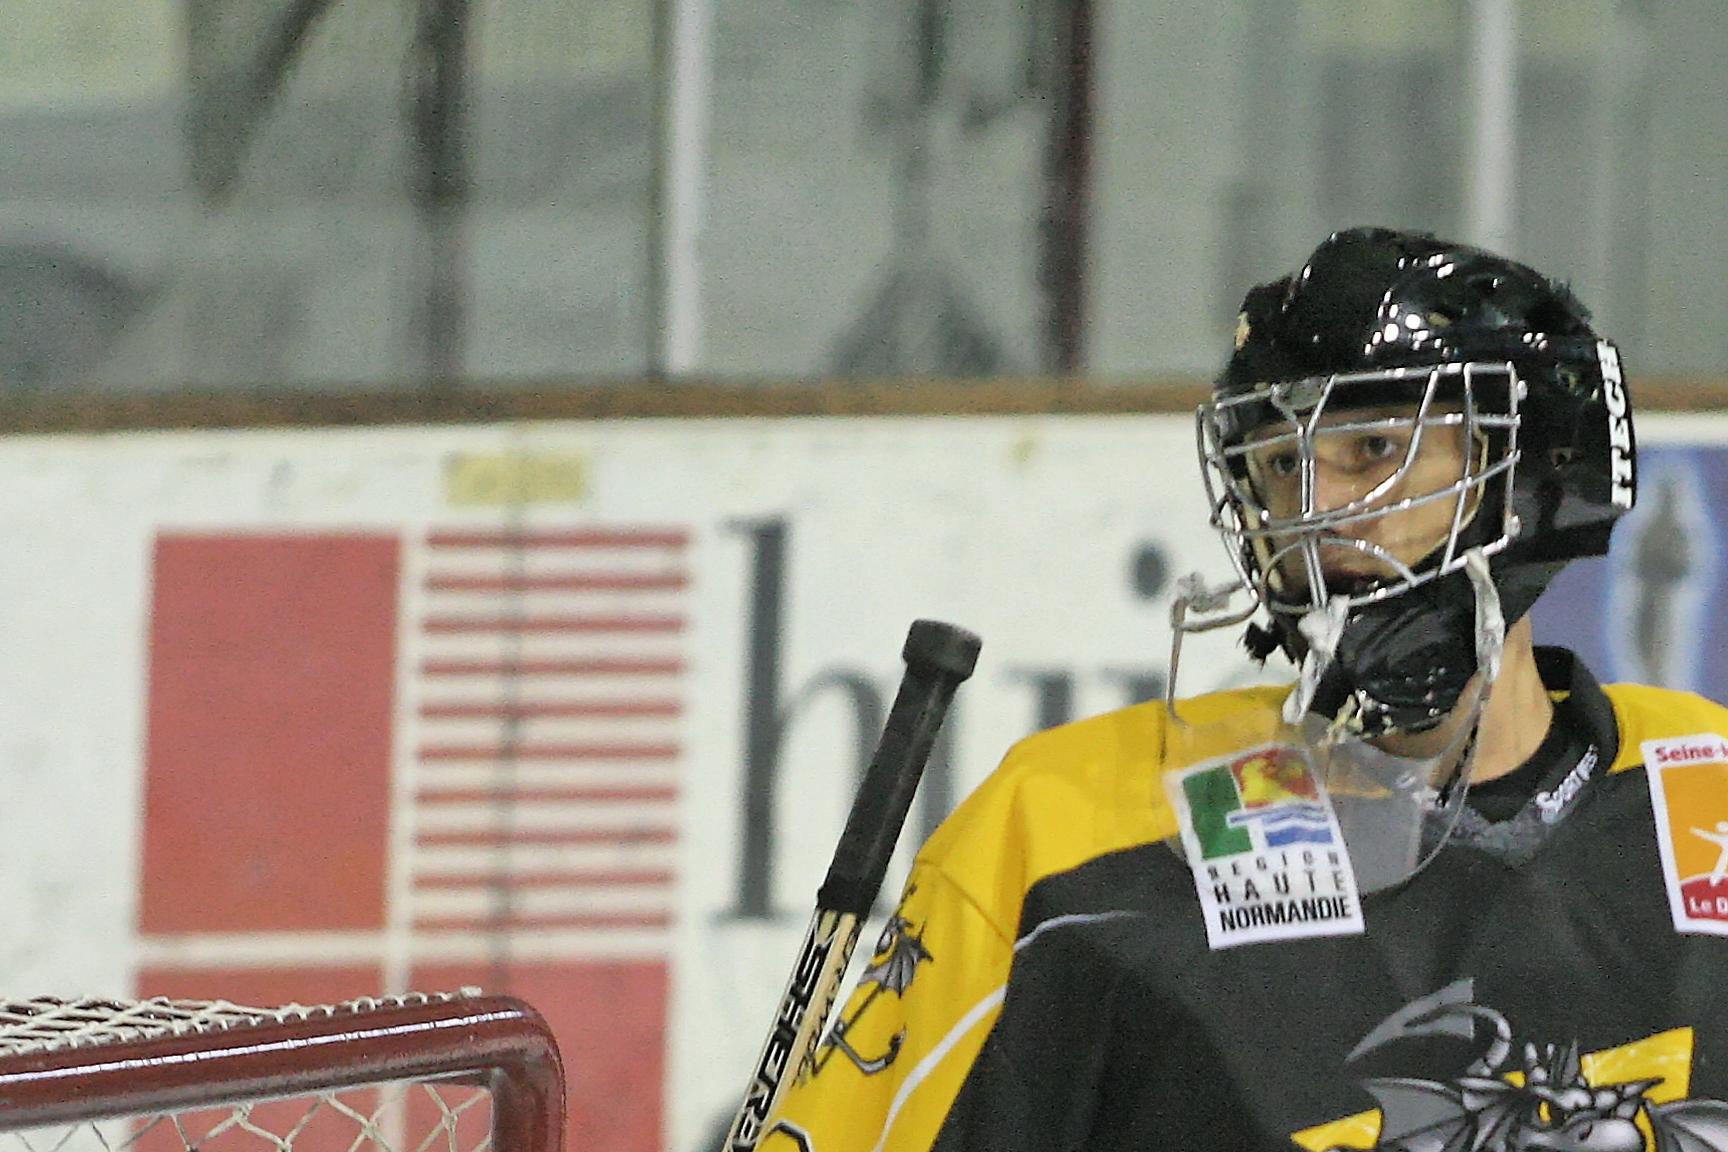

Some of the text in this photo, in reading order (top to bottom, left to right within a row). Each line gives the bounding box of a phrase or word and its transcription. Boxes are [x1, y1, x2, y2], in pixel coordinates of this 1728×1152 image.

[1213, 868, 1345, 904] HAUTE
[1219, 895, 1352, 932] NORMANDIE
[1689, 897, 1712, 914] Le
